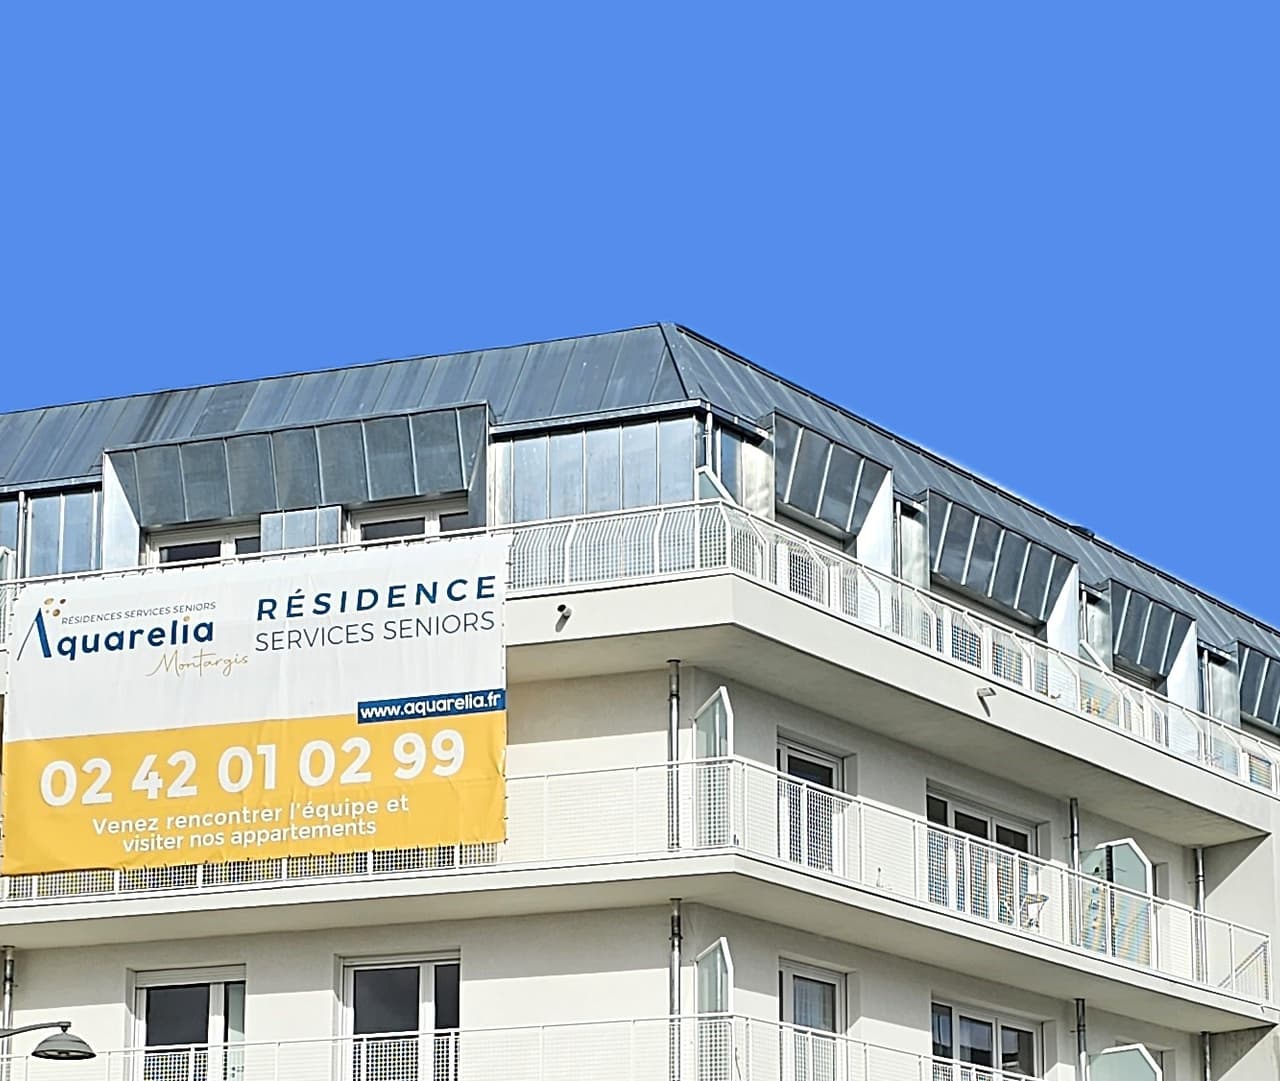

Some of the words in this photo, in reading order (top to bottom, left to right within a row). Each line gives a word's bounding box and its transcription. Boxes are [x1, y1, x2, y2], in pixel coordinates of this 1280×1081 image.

[124, 607, 171, 619] SERVICES
[173, 601, 217, 614] SENIORS
[256, 575, 496, 621] RÉSIDENCE
[17, 607, 214, 661] Aquarelia
[255, 622, 374, 652] SERVICES
[383, 611, 495, 640] SENIORS
[145, 648, 248, 677] Montargis
[360, 691, 501, 720] www.aquarelia.fr
[40, 757, 113, 807] 02
[131, 750, 198, 800] 42
[217, 743, 276, 793] 01
[299, 736, 372, 788] 02
[392, 729, 465, 780] 99
[92, 817, 158, 835] Venez
[166, 806, 282, 830] rencontrer
[289, 798, 379, 822] l'équipe
[386, 794, 409, 812] et
[122, 832, 184, 852] visiter
[190, 833, 225, 848] nos
[231, 818, 377, 847] appartements
